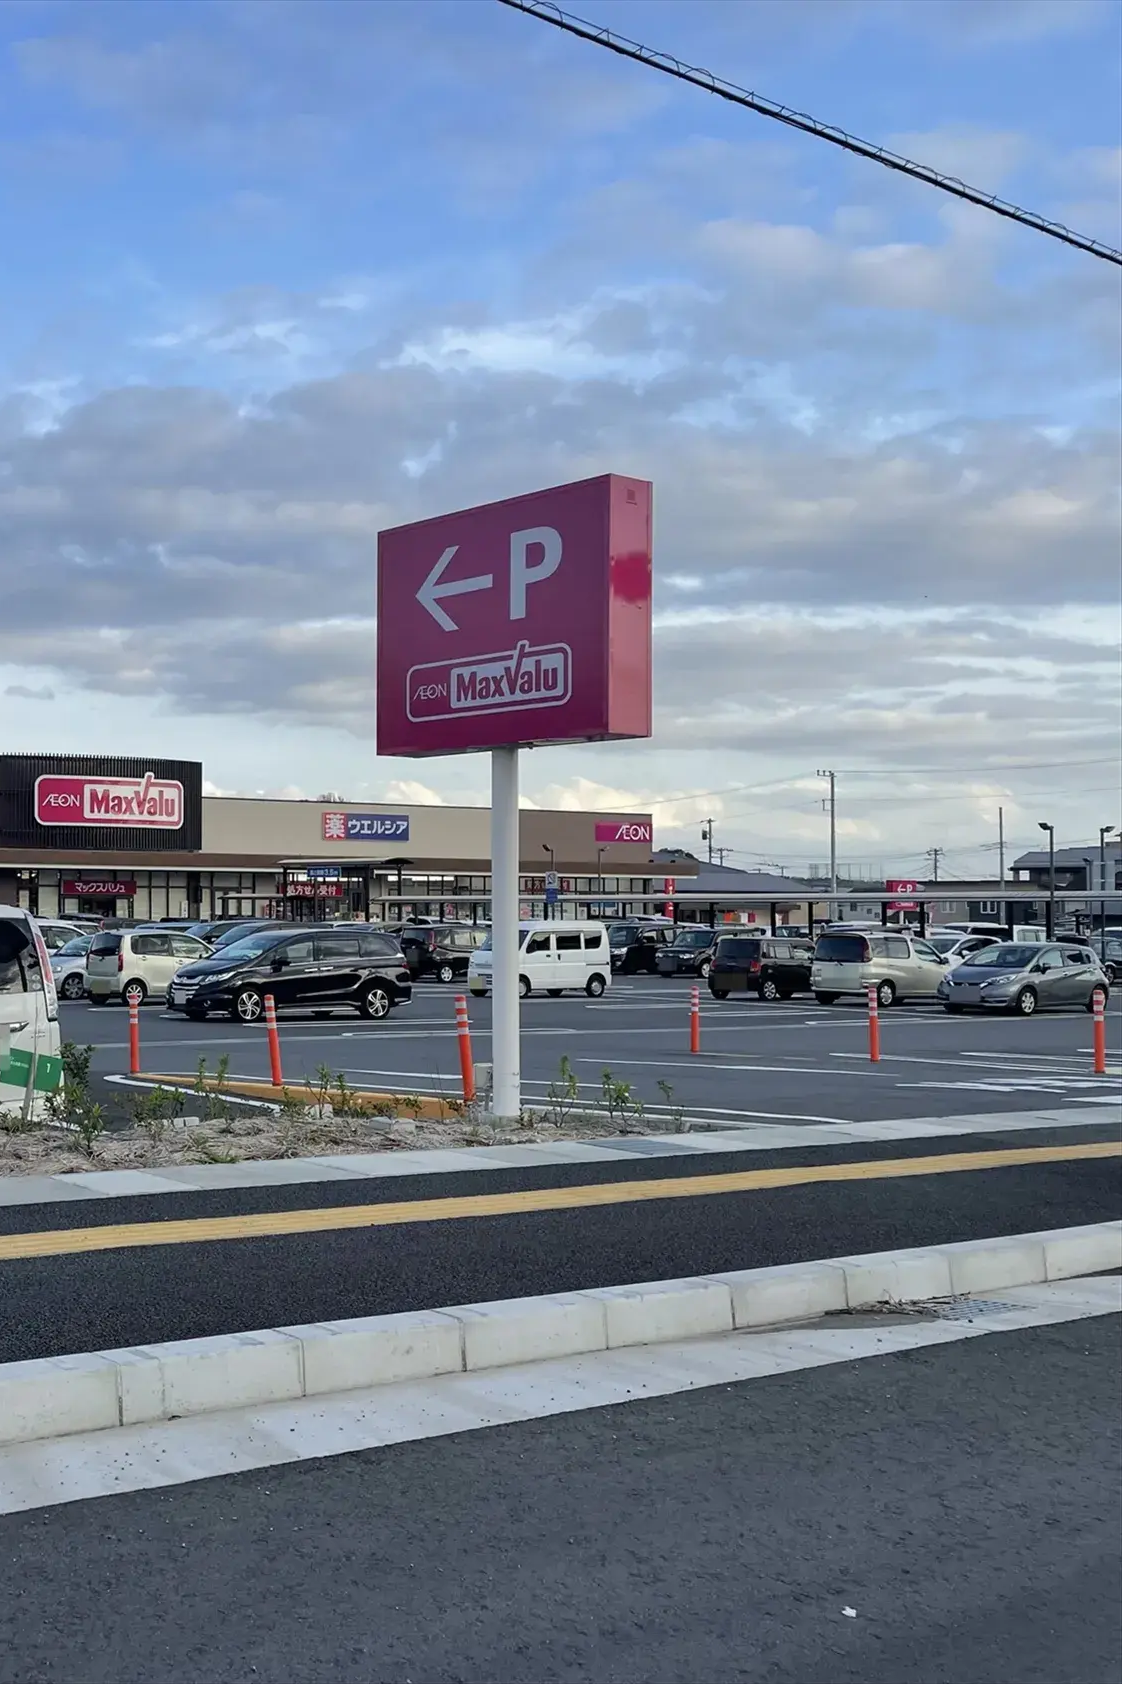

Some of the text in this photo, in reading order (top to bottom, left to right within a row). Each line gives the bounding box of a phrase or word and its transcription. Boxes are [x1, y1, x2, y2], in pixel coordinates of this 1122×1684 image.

[509, 526, 564, 620] P
[456, 643, 559, 703] MaxValu
[89, 774, 176, 817] MaxValu
[74, 882, 126, 893] マックスバリュ
